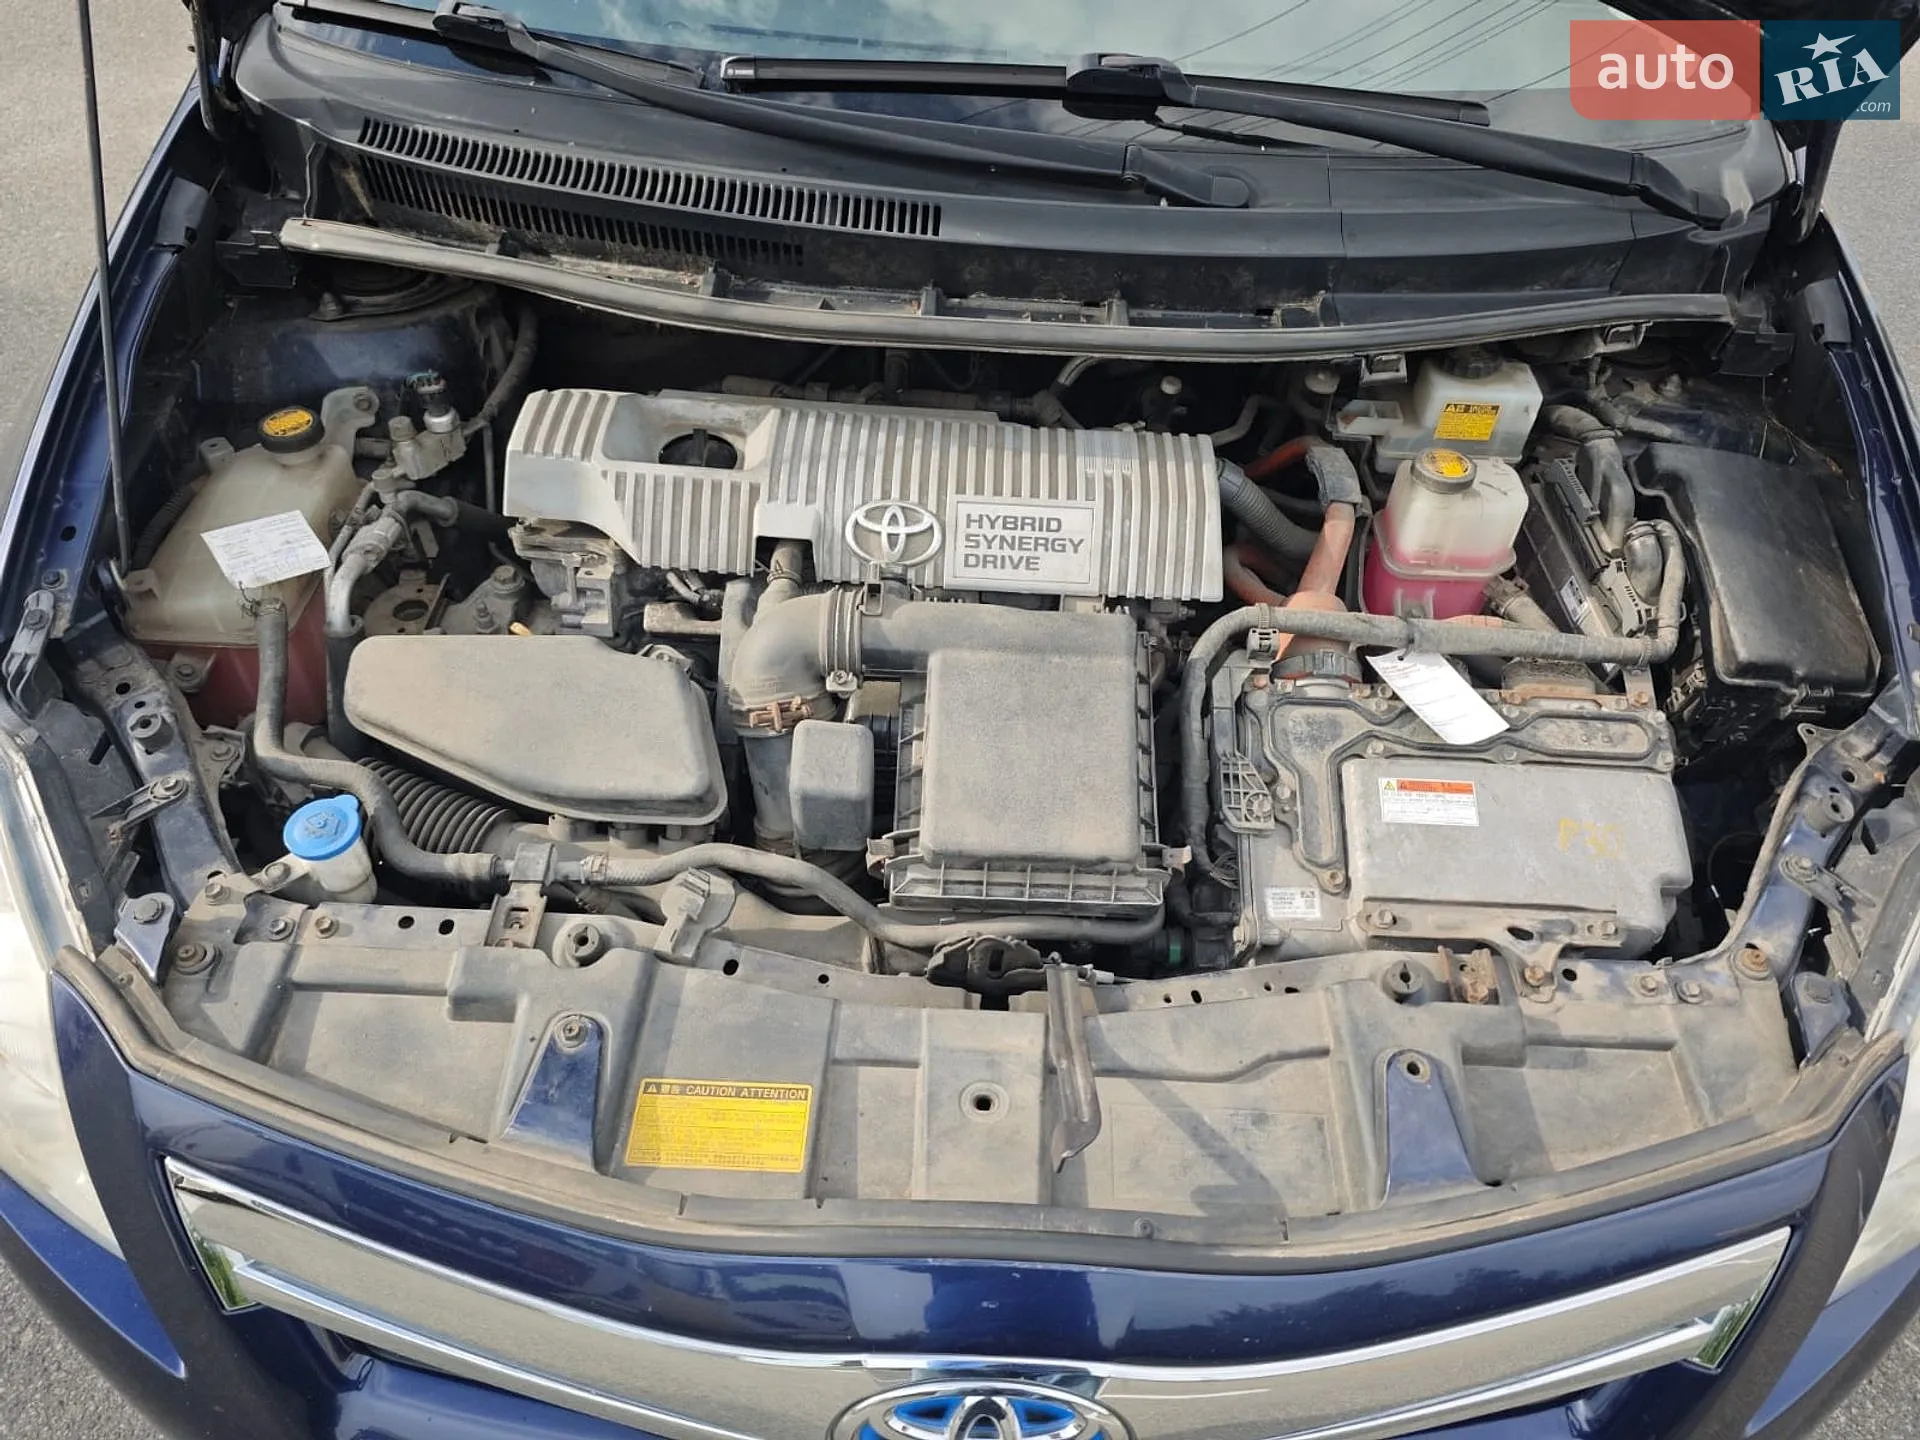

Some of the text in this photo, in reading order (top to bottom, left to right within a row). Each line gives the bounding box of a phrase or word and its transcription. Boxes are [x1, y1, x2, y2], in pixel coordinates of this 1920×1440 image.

[965, 513, 1062, 533] HYBRID
[964, 533, 1085, 554] SYNERGY
[963, 553, 1041, 571] DRIVE
[686, 1084, 736, 1097] CAUTION
[740, 1086, 806, 1100] ATTENTION
